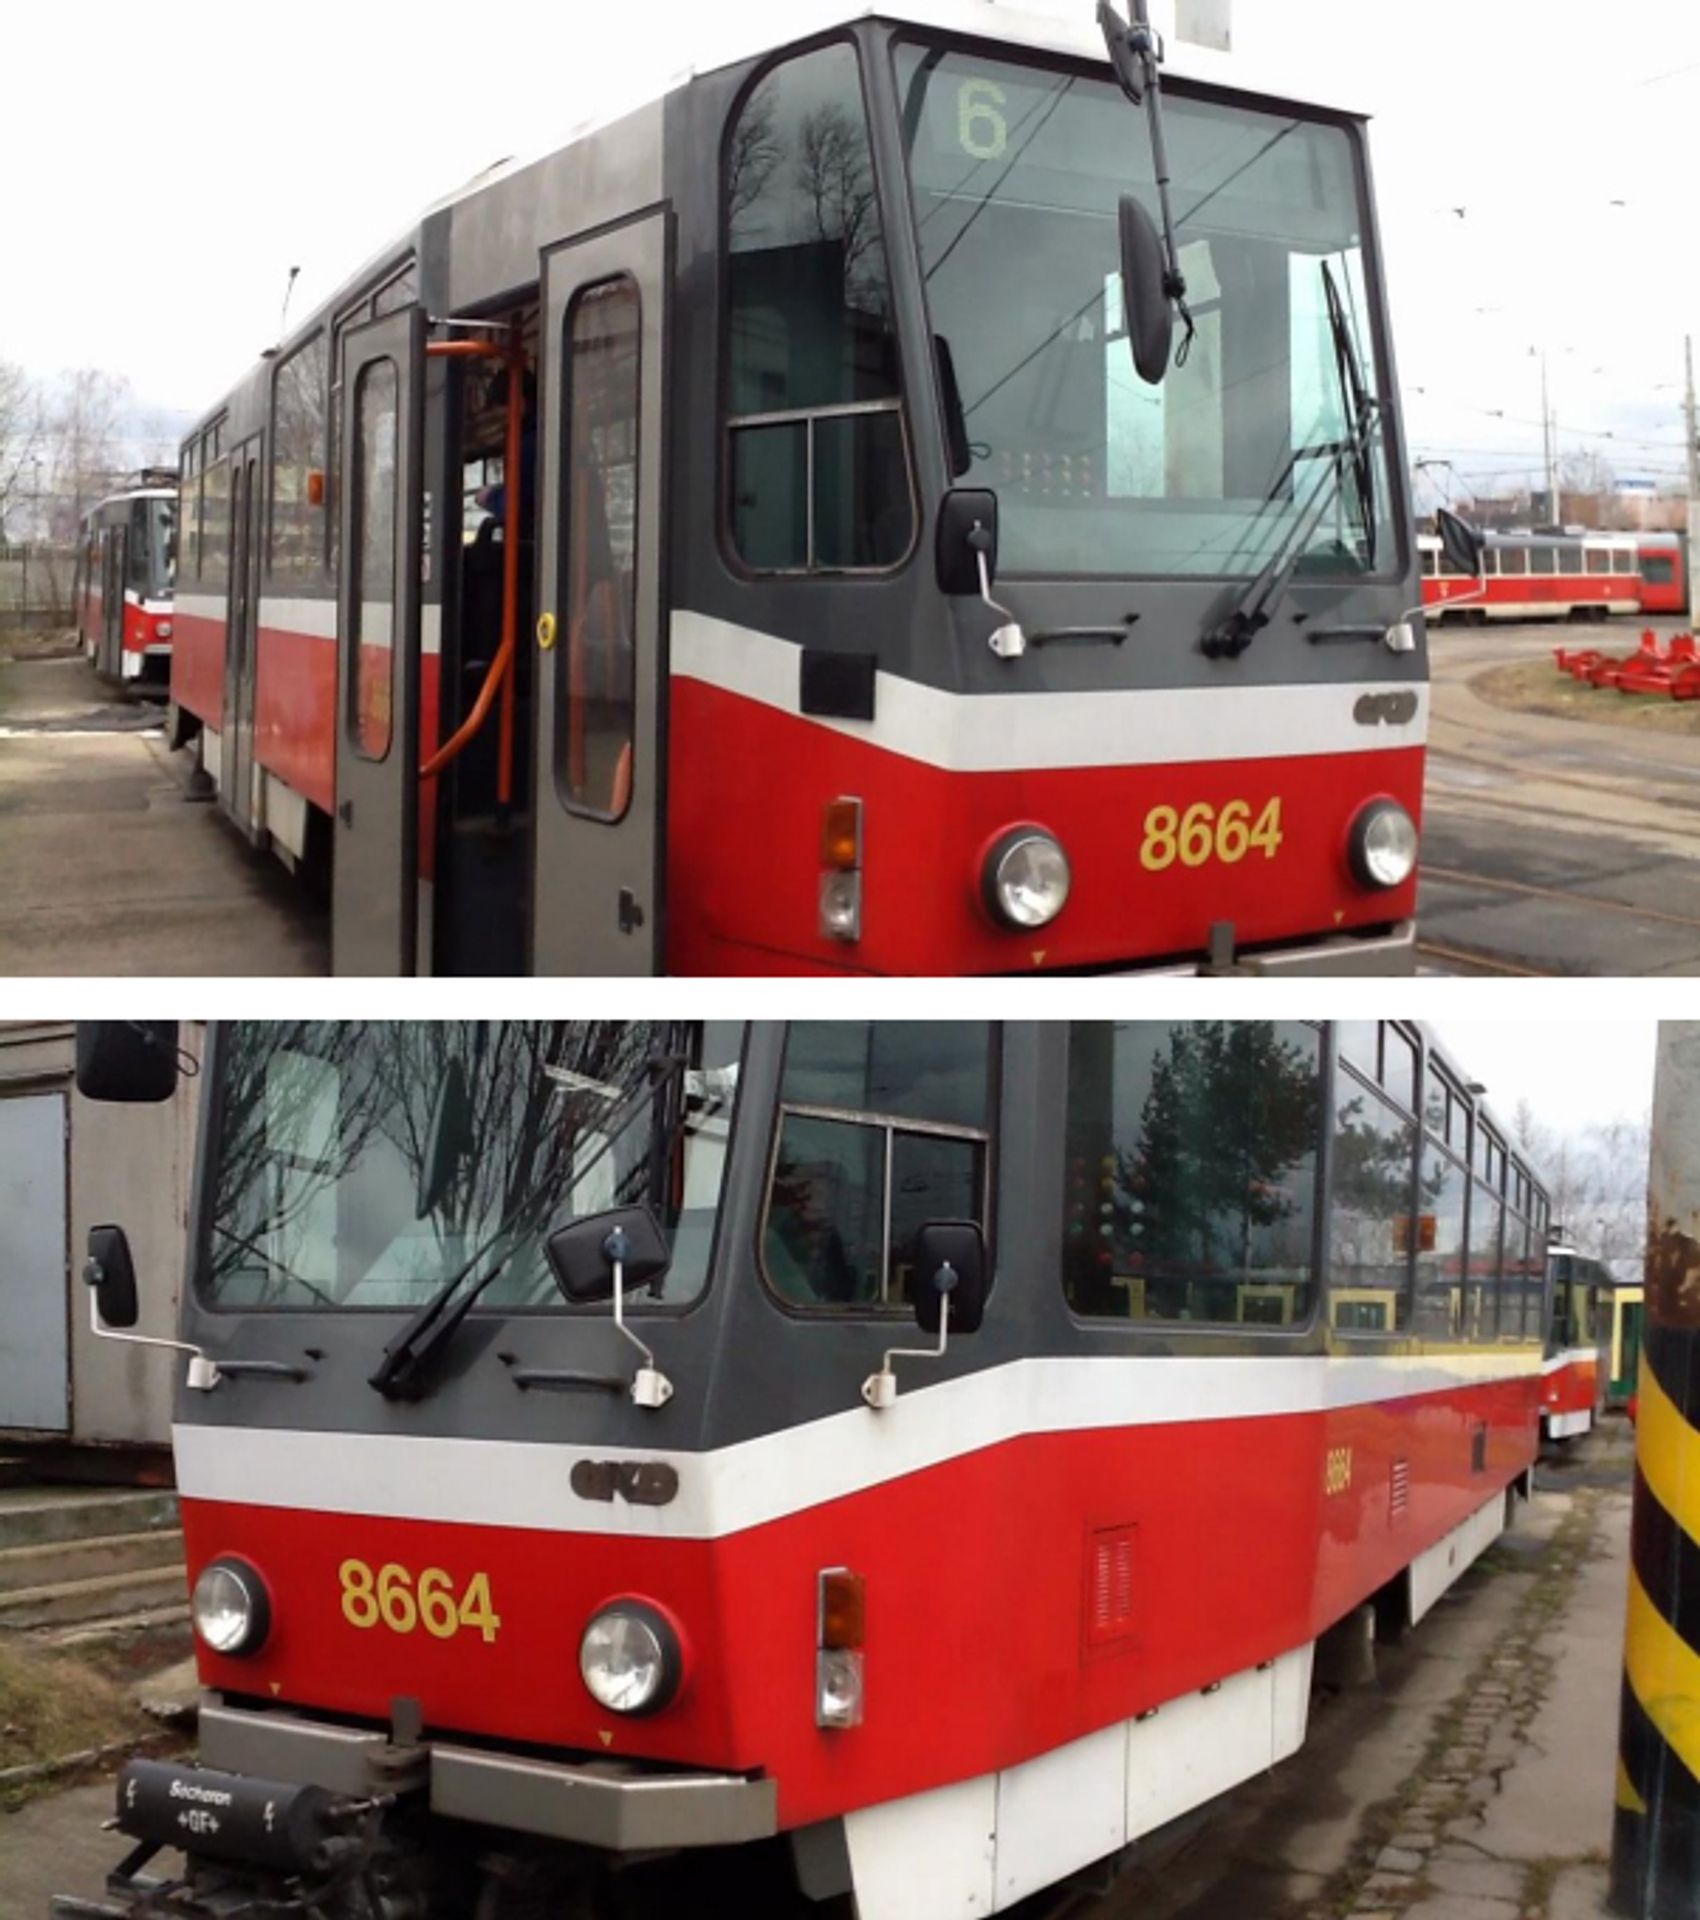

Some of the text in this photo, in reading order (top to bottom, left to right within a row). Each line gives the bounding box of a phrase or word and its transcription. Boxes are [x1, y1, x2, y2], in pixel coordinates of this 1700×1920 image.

[958, 79, 1007, 159] 6
[1140, 796, 1283, 871] 8664
[339, 1558, 500, 1642] 8664
